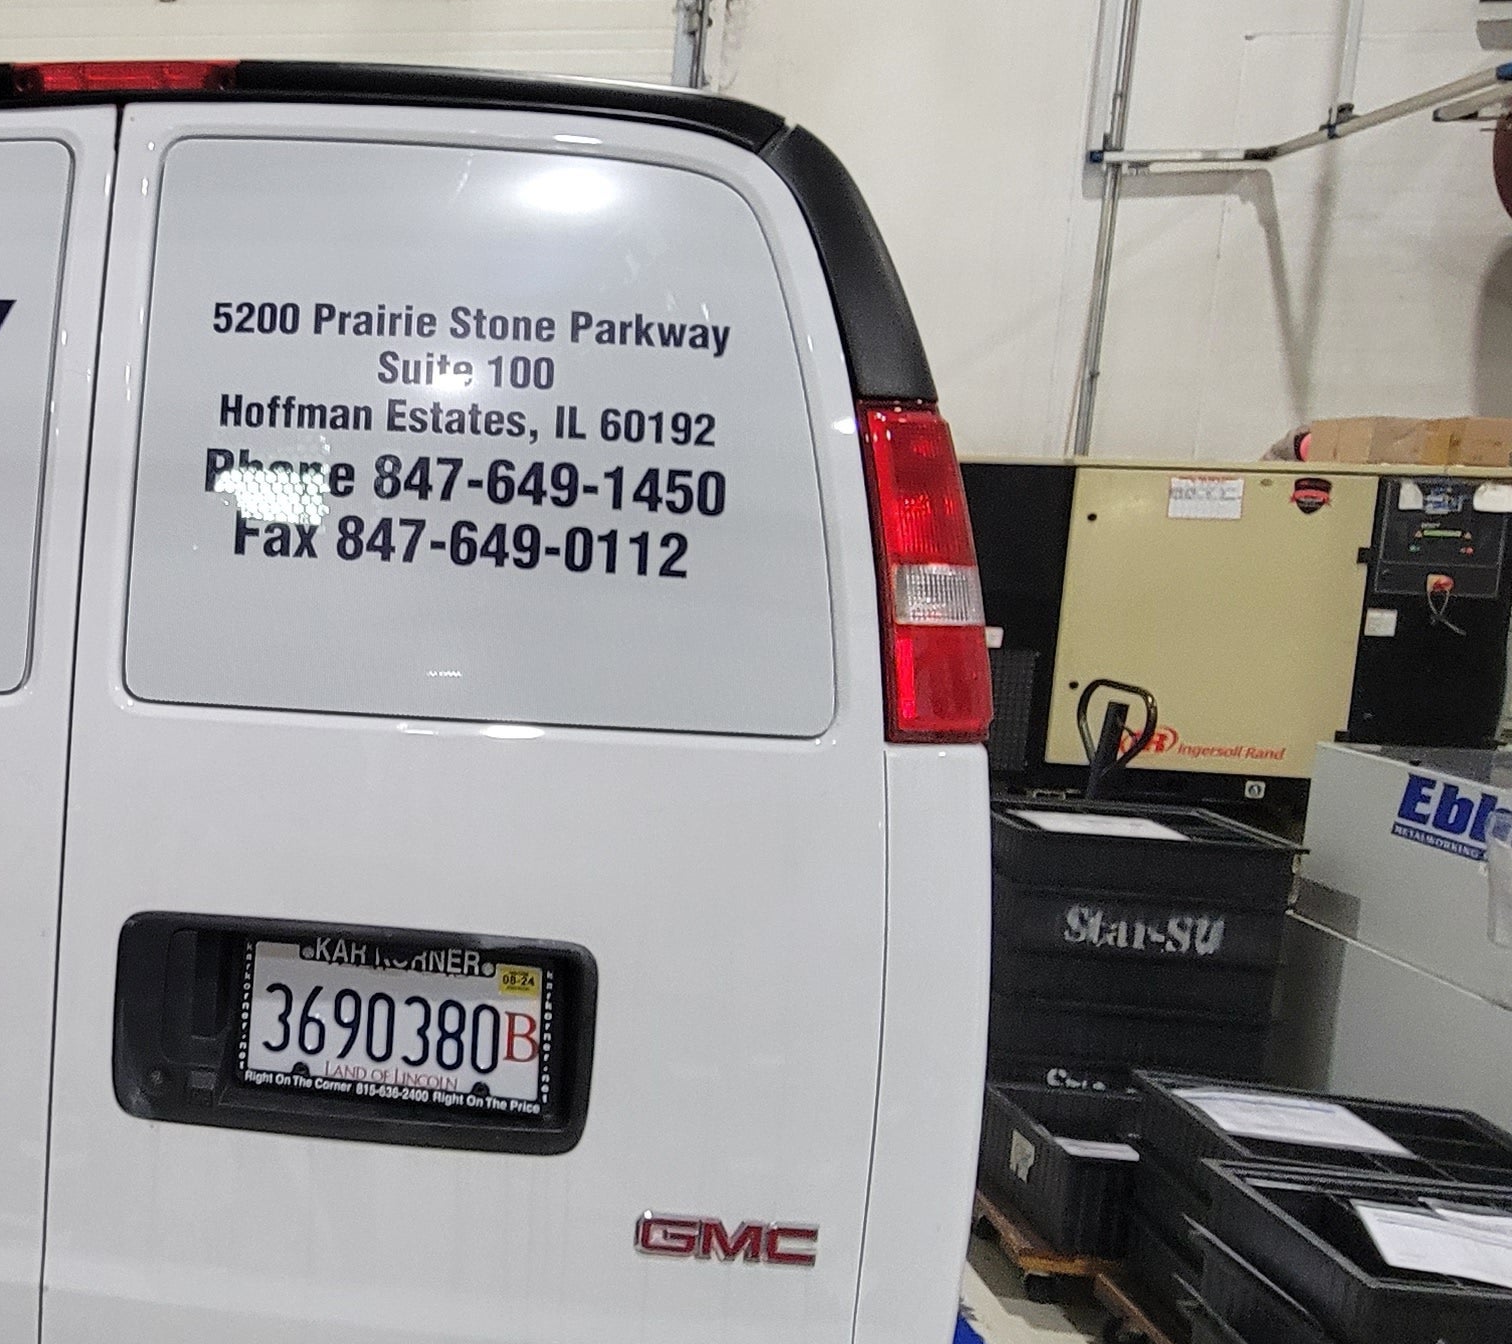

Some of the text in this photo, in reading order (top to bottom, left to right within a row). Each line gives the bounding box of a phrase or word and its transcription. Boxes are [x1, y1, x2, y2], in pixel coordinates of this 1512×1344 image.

[213, 302, 732, 357] 5200 Prairie Stone Parkway
[377, 350, 555, 390] Suite 100
[220, 394, 716, 447] Hoffman Estates, IL 60192
[374, 454, 726, 518] 847-649-1450
[234, 509, 688, 578] Fax 847-649-0112
[1177, 744, 1243, 758] Ingersoll
[1245, 747, 1286, 761] Rand
[245, 1070, 273, 1085] Right
[275, 1073, 291, 1086] On
[292, 1074, 313, 1089] The
[314, 1077, 352, 1093] Corner
[432, 1090, 464, 1107] Right
[466, 1094, 484, 1108] On
[485, 1096, 507, 1112] The
[509, 1099, 541, 1115] Price
[634, 1210, 820, 1268] GMC
